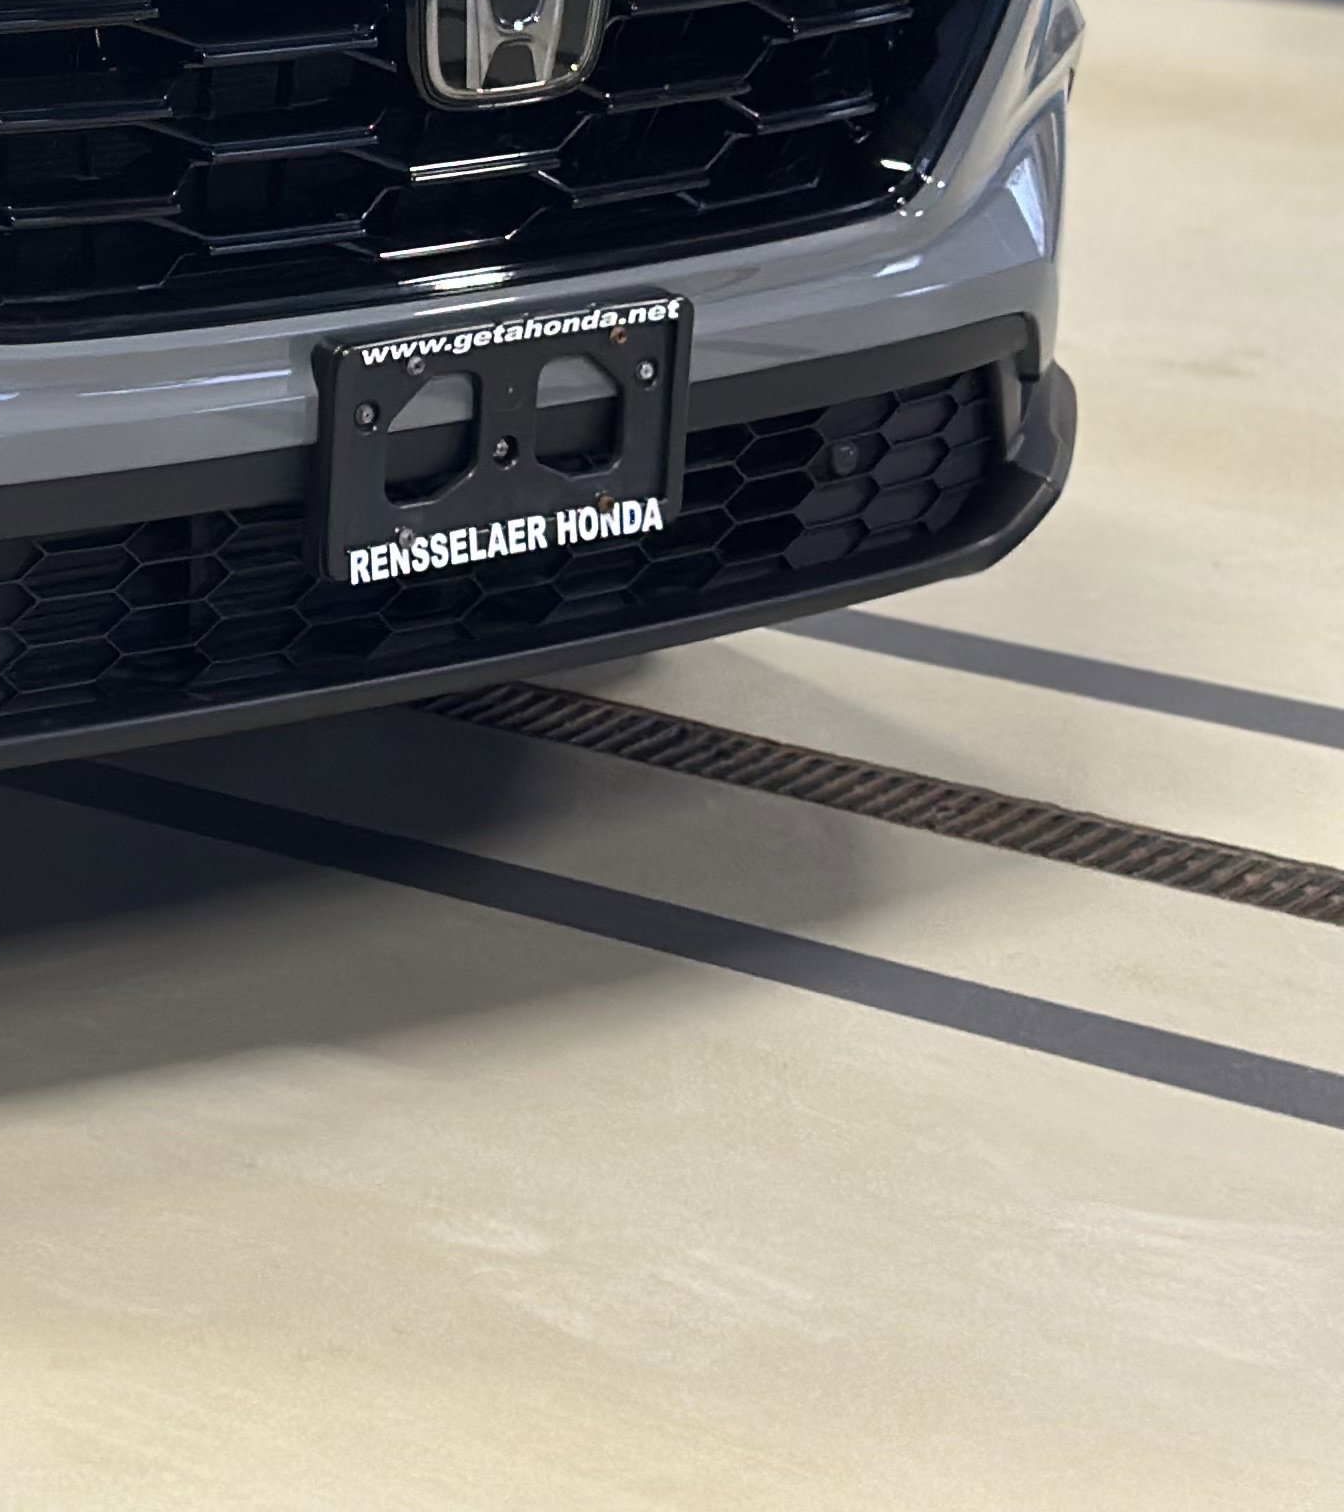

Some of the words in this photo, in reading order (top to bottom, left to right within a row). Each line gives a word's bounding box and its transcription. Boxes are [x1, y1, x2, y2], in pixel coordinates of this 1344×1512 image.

[361, 298, 681, 366] www.getahonda.net
[349, 519, 548, 585] RENSSELAER
[556, 497, 664, 546] HONDA
